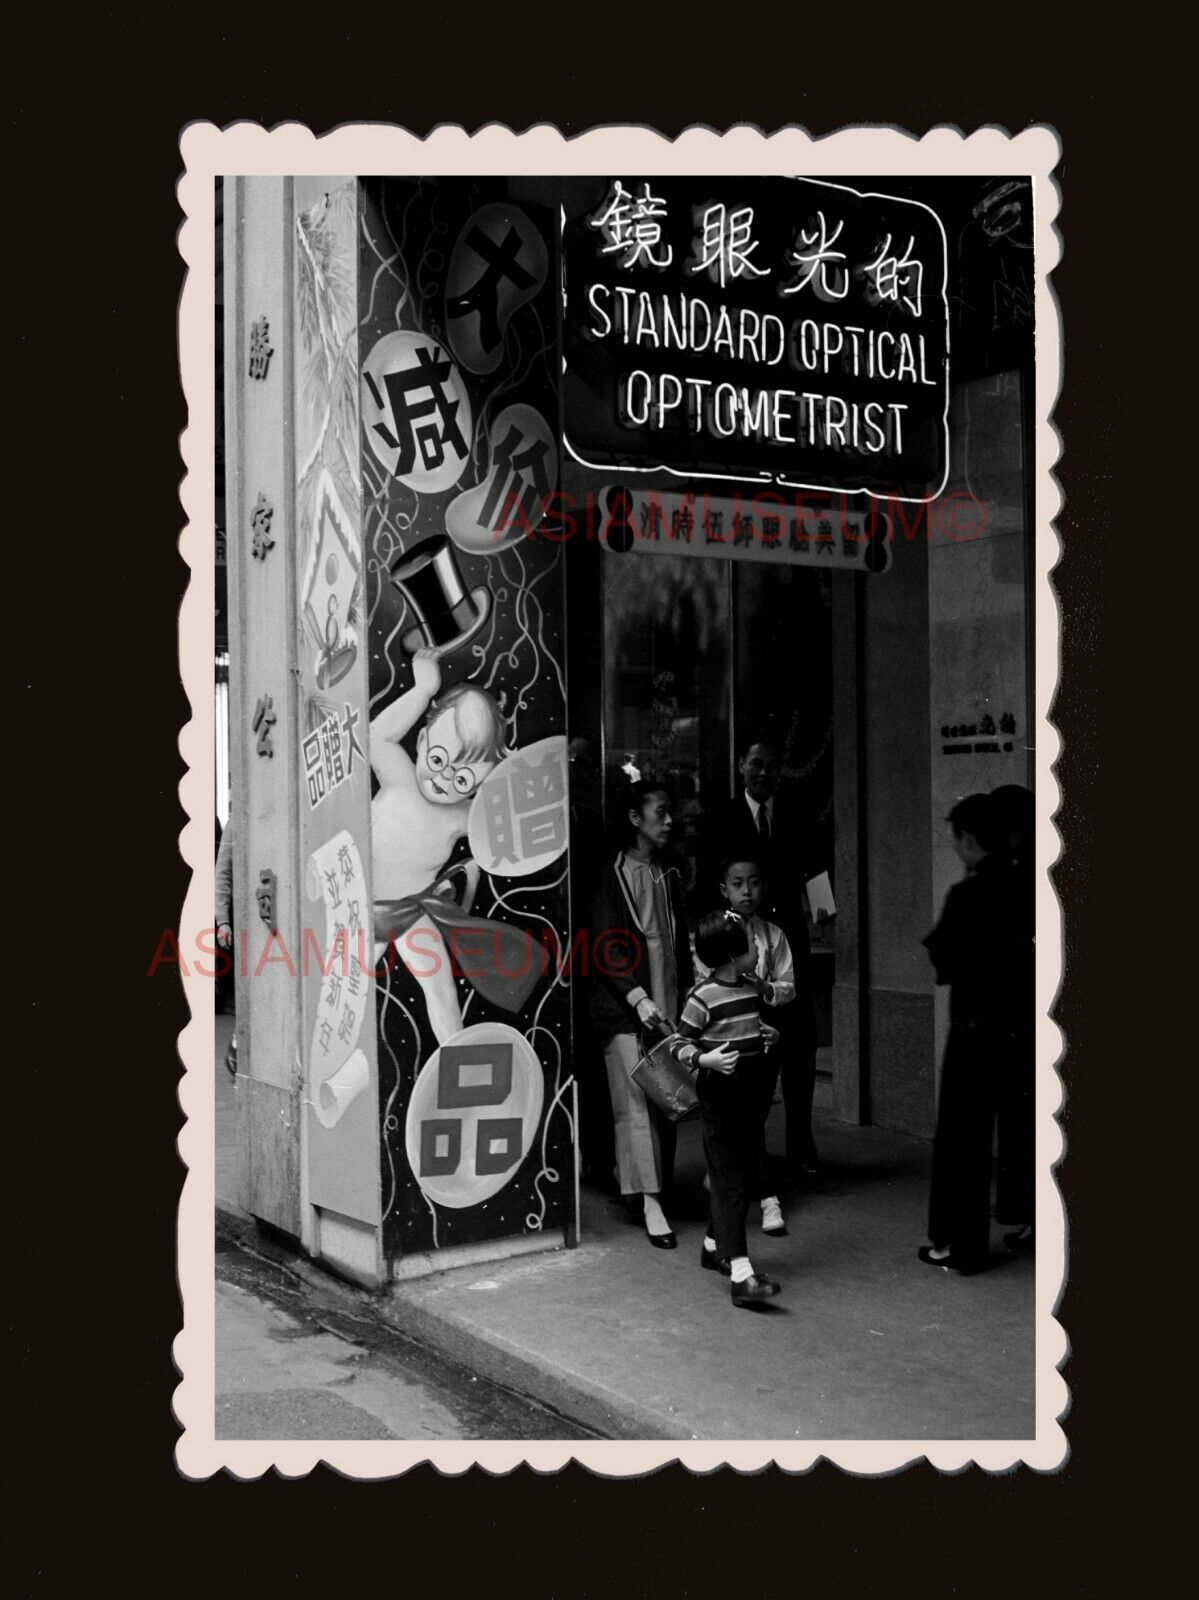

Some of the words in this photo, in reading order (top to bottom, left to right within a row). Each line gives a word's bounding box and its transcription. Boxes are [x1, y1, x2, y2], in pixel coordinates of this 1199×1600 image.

[588, 283, 786, 366] STANDARD
[800, 319, 937, 386] OPTICAL
[626, 370, 909, 456] OPTOMETRIST
